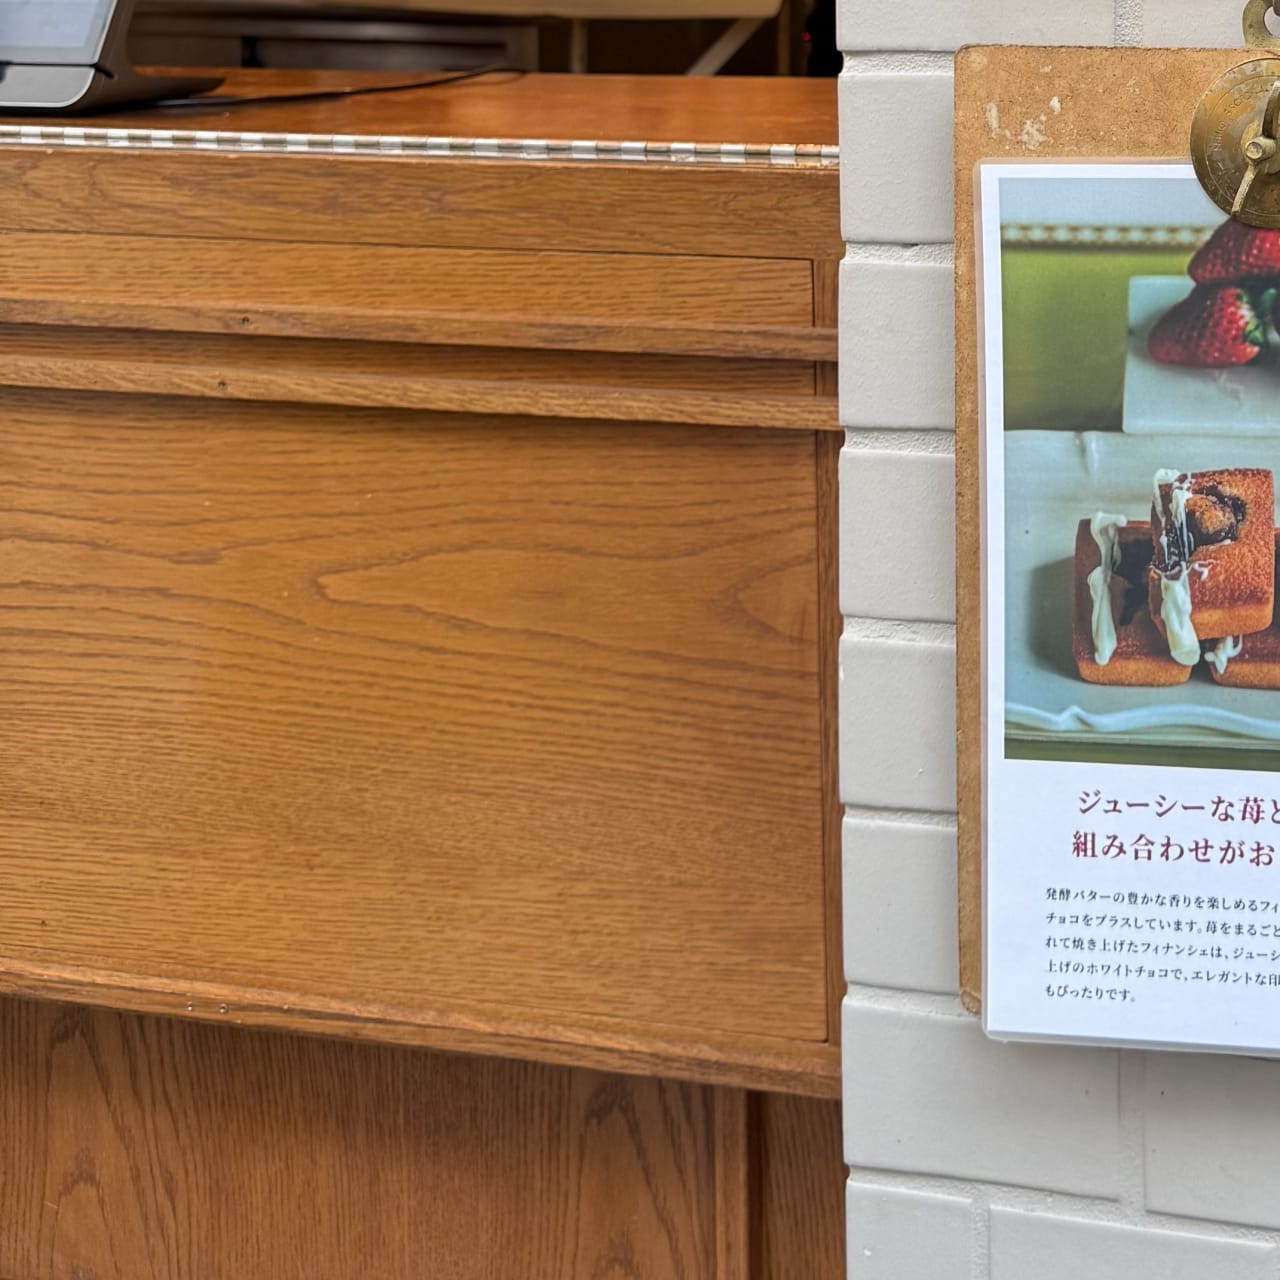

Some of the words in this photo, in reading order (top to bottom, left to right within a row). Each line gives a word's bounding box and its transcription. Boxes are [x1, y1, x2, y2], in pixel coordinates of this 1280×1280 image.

[1046, 984, 1136, 1003] もぴったりです。
